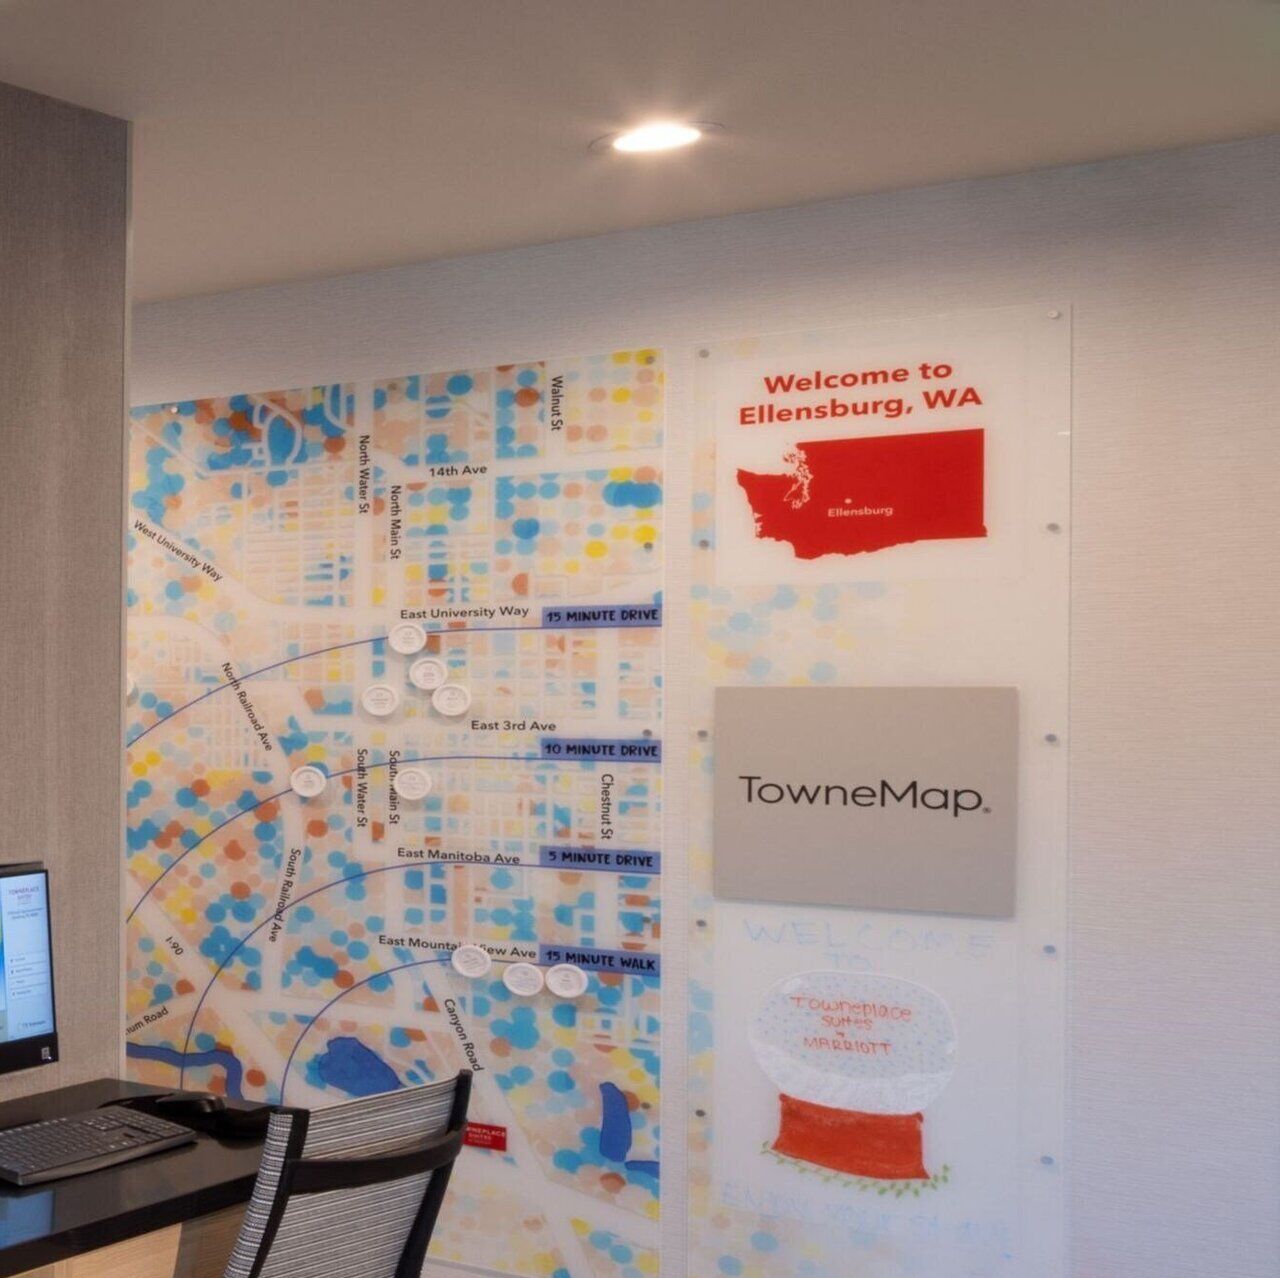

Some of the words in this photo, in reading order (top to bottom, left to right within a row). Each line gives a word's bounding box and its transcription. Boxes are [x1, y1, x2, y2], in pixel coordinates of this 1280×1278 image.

[764, 369, 909, 394] Welcome
[919, 362, 953, 380] to
[551, 375, 564, 419] Walnut
[739, 398, 913, 426] Ellensburg,
[923, 387, 983, 410] WA
[551, 421, 564, 431] St
[359, 435, 370, 460] North
[358, 463, 370, 497] Water
[430, 467, 458, 477] 14th
[462, 466, 487, 475] Ave
[358, 502, 370, 514] St
[391, 485, 401, 514] North
[828, 505, 893, 518] Ellensburg
[391, 517, 401, 544] Main
[134, 520, 156, 540] West
[157, 534, 200, 569] University
[199, 561, 223, 582] Way
[390, 549, 401, 560] St
[400, 609, 427, 620] East
[430, 607, 496, 620] University
[499, 606, 529, 618] Way
[545, 611, 561, 623] 15
[566, 610, 616, 622] MINUTE
[621, 608, 658, 621] DRIVE
[222, 662, 241, 691] North
[237, 690, 265, 732] Railroad
[258, 732, 272, 751] Ave
[471, 720, 499, 731] East
[503, 720, 526, 731] 3rd
[530, 720, 556, 731] Ave
[545, 743, 561, 755] 10
[566, 744, 616, 756] MINUTE
[621, 745, 658, 757] DRIVE
[357, 748, 368, 779] South
[356, 782, 368, 816] Water
[601, 774, 613, 827] Chestnut
[357, 818, 368, 828] St
[389, 814, 400, 824] St
[601, 829, 612, 840] St
[285, 849, 301, 878] South
[397, 848, 424, 859] East
[427, 850, 490, 864] Manitoba
[494, 854, 520, 865] Ave
[549, 851, 557, 862] 5
[562, 852, 611, 866] MINUTE
[616, 854, 653, 867] DRIVE
[274, 879, 293, 922] Railroad
[268, 923, 282, 943] Ave
[379, 935, 404, 946] East
[408, 938, 463, 951] Mountai
[479, 943, 507, 956] iew
[510, 947, 536, 959] Ave
[546, 951, 560, 962] 15
[565, 952, 615, 967] MINUTE
[620, 956, 655, 970] WALK
[143, 1006, 169, 1025] Road
[444, 998, 468, 1043] Canyon
[464, 1043, 484, 1072] Road
